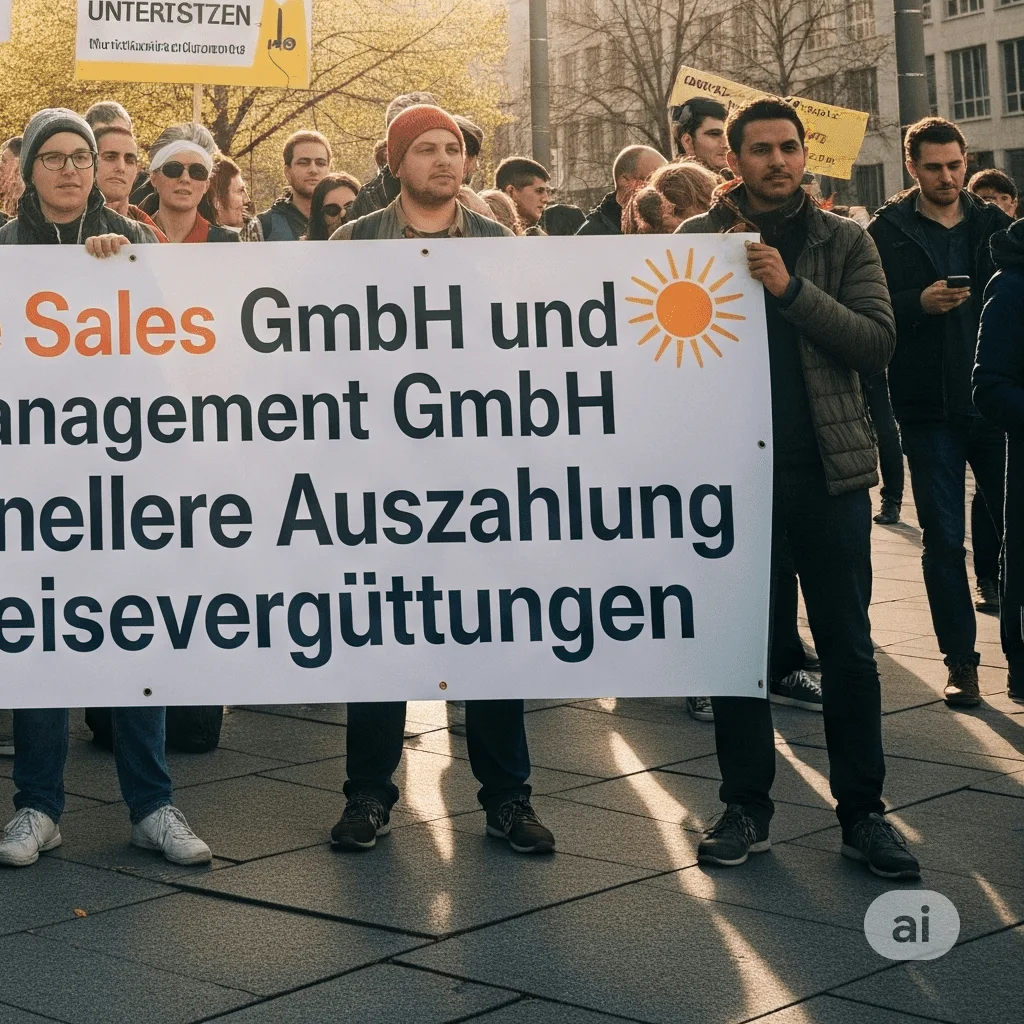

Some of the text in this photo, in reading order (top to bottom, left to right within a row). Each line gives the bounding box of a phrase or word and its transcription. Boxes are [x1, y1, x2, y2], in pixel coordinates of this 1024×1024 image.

[24, 289, 217, 358] Sales
[240, 284, 465, 354] GmbH
[490, 281, 619, 350] und
[393, 369, 616, 440] GmbH
[276, 465, 736, 560] Auszahlung
